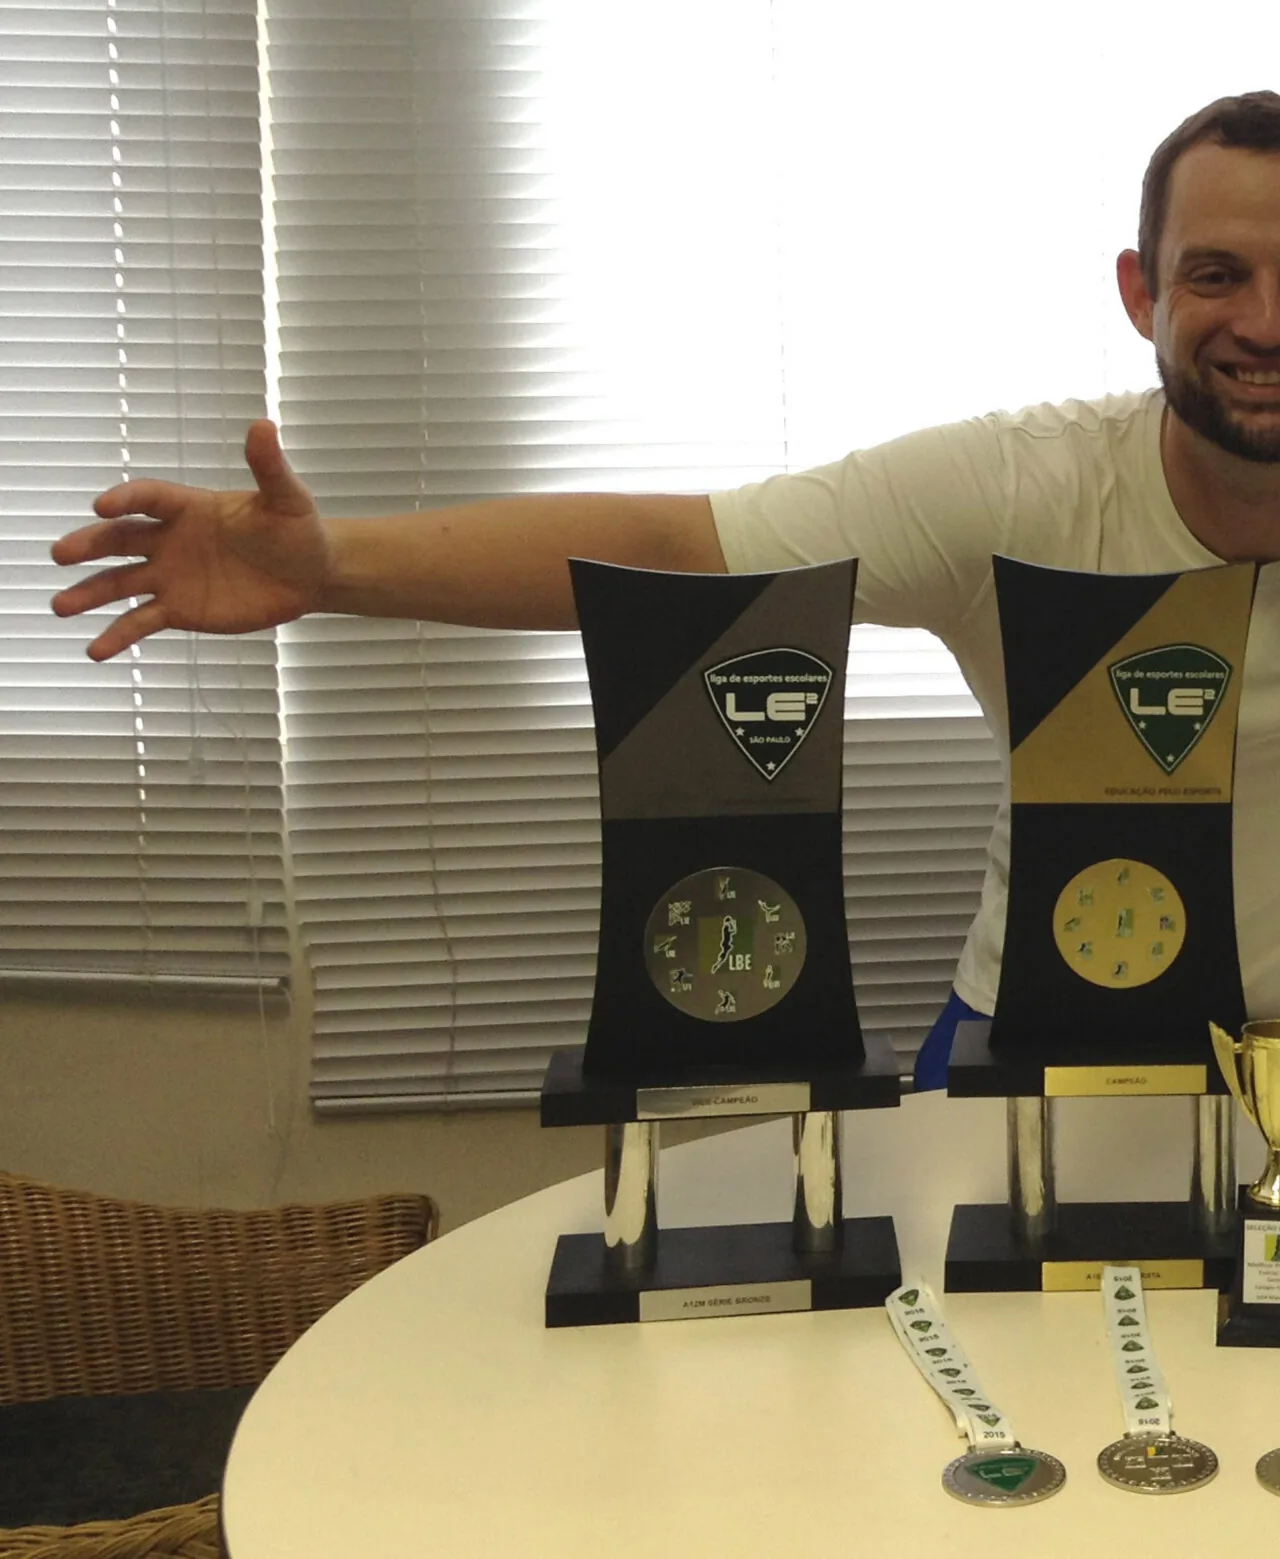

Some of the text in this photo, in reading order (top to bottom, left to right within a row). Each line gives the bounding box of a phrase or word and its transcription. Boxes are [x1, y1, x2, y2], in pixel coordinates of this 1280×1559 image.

[710, 673, 827, 685] liga de esportes escolares
[1134, 669, 1145, 678] de
[1146, 670, 1183, 680] esportes
[749, 735, 791, 744] SÃO PAULO
[729, 954, 752, 970] LBE
[983, 1431, 1006, 1439] 2015
